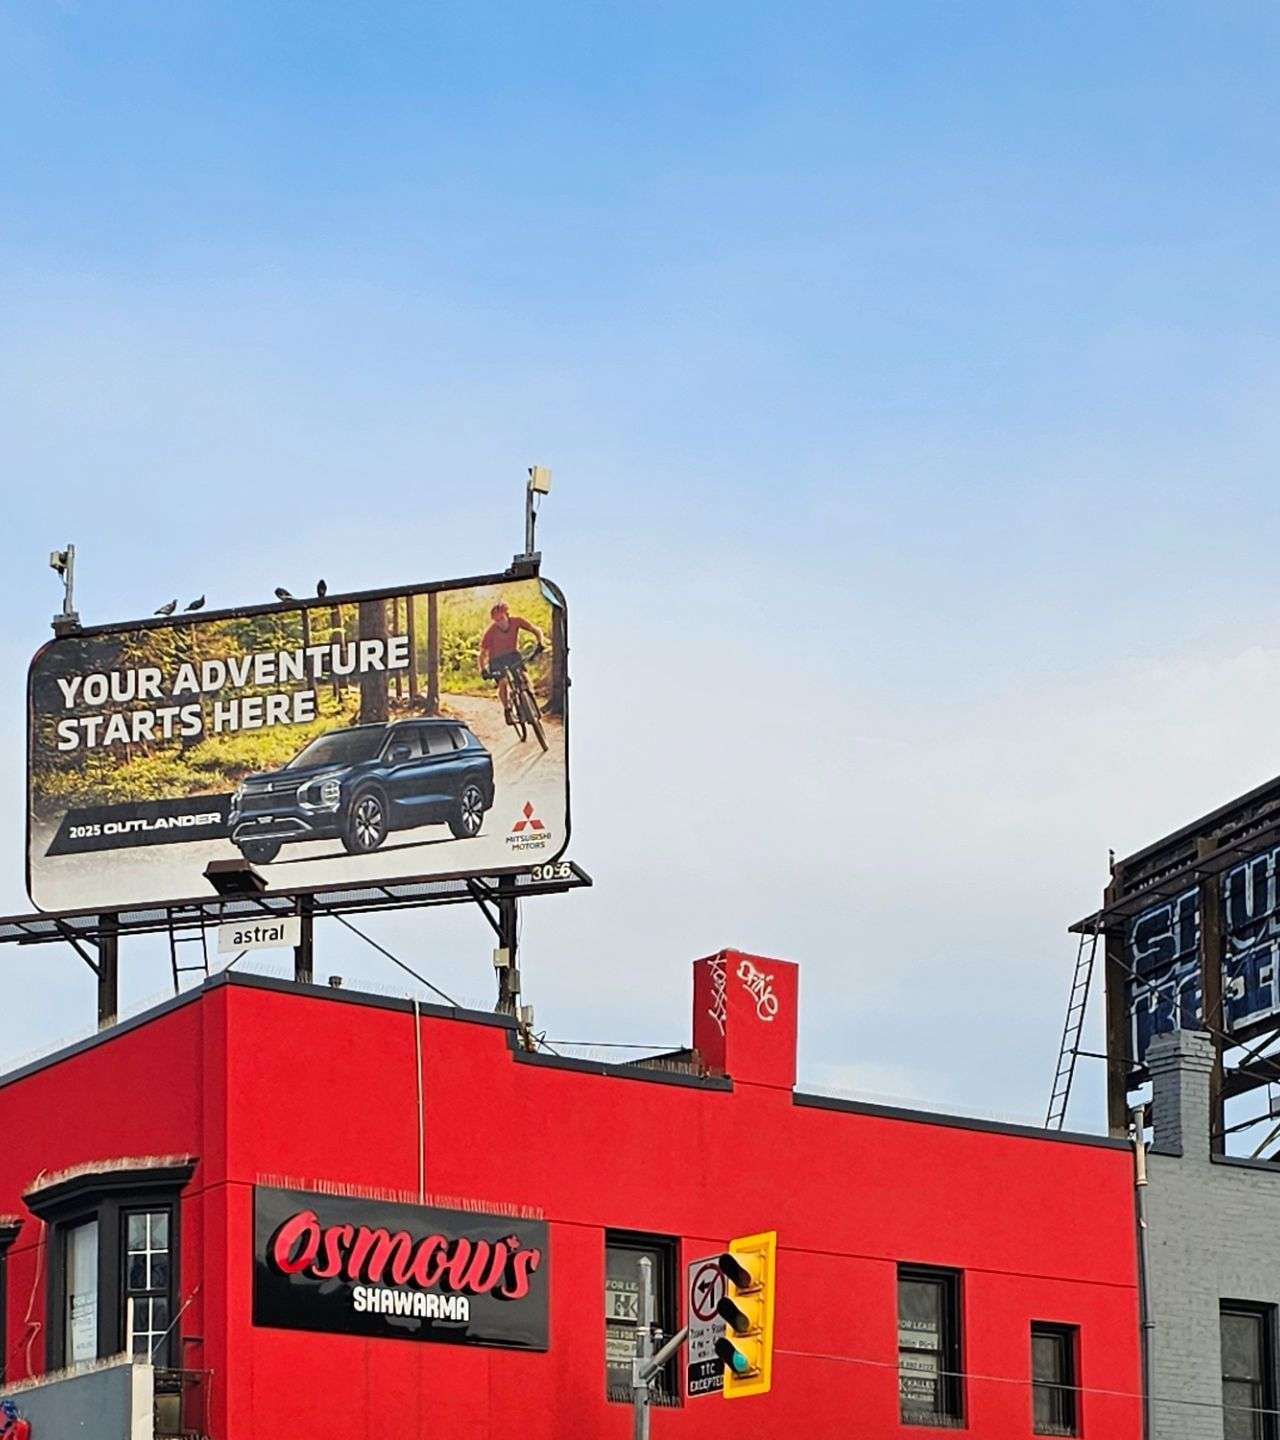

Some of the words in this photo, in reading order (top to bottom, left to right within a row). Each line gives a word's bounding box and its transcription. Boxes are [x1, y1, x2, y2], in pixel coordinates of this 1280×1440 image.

[57, 667, 163, 709] YOUR
[173, 636, 410, 695] ADVENTURE
[57, 704, 202, 750] STARTS
[214, 690, 315, 732] HERE
[69, 824, 101, 838] 2025
[104, 812, 221, 835] OUTLANDER
[506, 832, 551, 843] MITSUBISHI
[512, 842, 545, 851] MOTORS
[233, 924, 284, 945] astral
[274, 1209, 541, 1299] Osmow's
[353, 1286, 469, 1321] SHAWARMA
